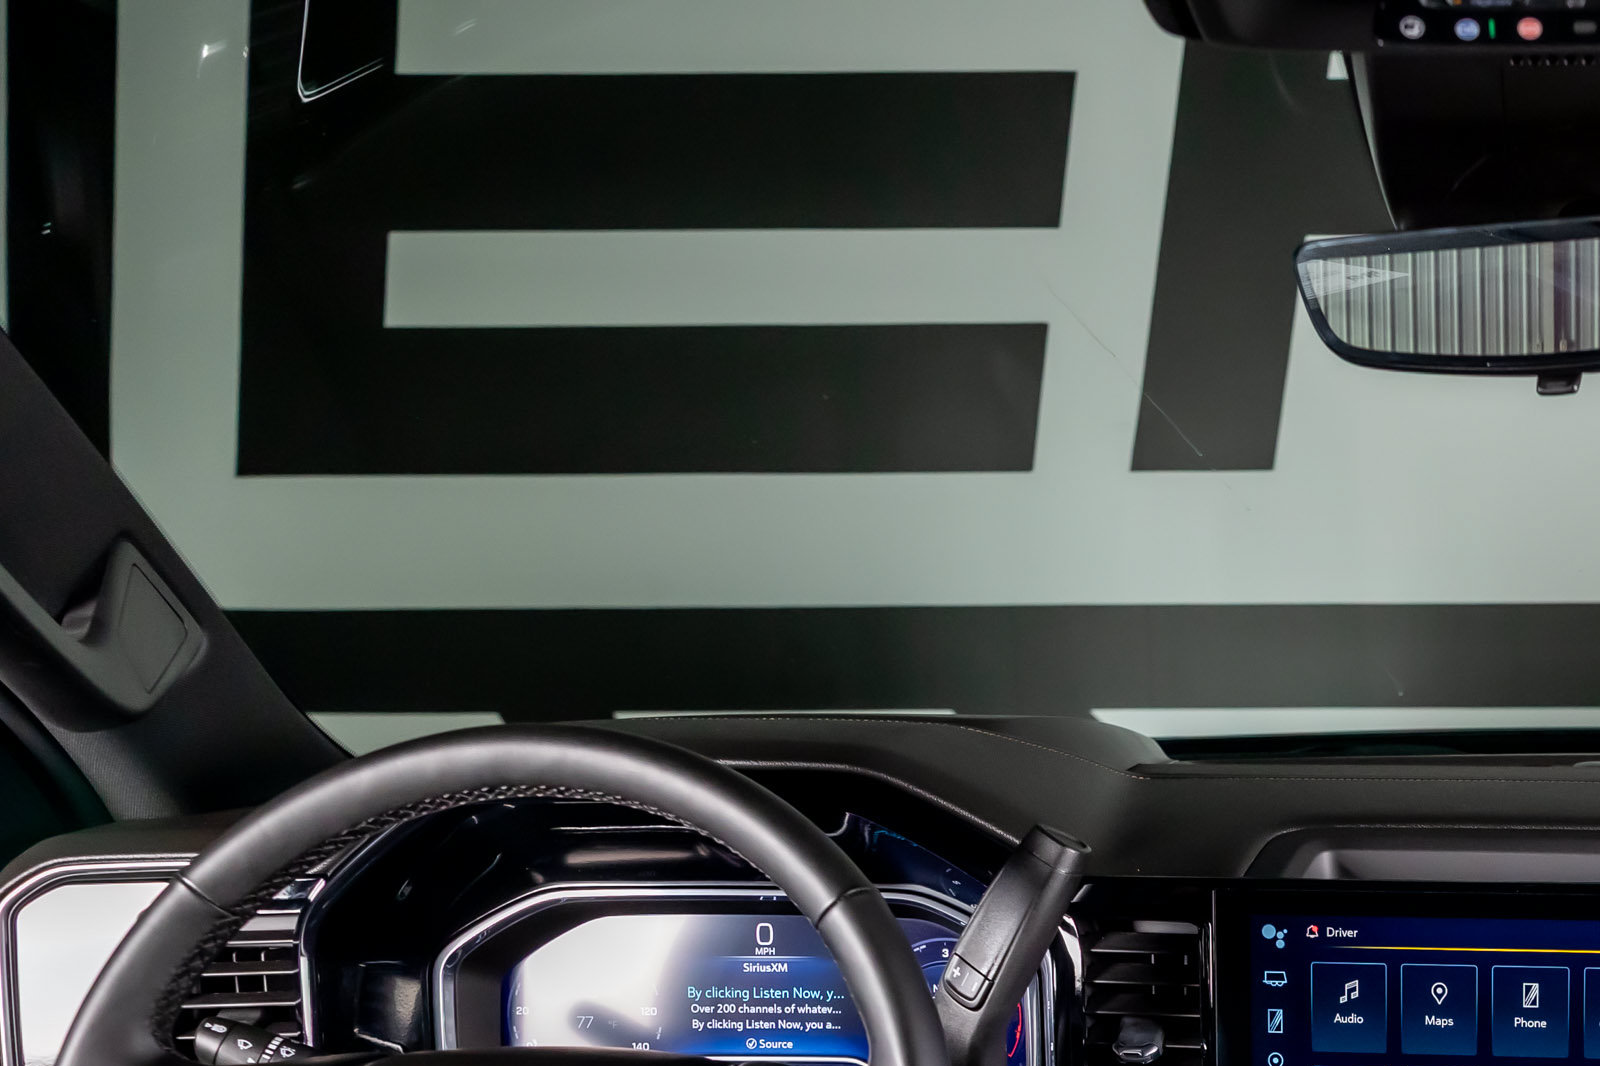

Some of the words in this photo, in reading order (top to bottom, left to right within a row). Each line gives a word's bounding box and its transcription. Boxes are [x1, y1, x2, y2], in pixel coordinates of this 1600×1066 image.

[755, 922, 775, 946] 0
[1326, 926, 1359, 938] Driver
[754, 947, 776, 956] MPH
[941, 948, 950, 958] 3
[742, 962, 789, 973] SiriusXM
[687, 985, 703, 1002] By
[705, 985, 750, 1002] clicking
[752, 986, 790, 1000] Listen
[792, 986, 824, 1002] Now,
[826, 989, 845, 1002] y...
[640, 1006, 658, 1017] 120
[690, 1003, 715, 1014] Over
[716, 1003, 737, 1014] 200
[738, 1002, 783, 1014] channels
[784, 1002, 797, 1014] of
[797, 1003, 842, 1015] whatev...
[576, 1015, 595, 1030] 77
[1333, 1012, 1365, 1025] Audio
[1424, 1015, 1455, 1029] Maps
[1513, 1016, 1548, 1029] Phone
[692, 1018, 705, 1032] By
[706, 1018, 744, 1032] clicking
[745, 1019, 776, 1031] Listen
[777, 1019, 804, 1032] Now,
[805, 1021, 824, 1033] you
[825, 1022, 842, 1030] a...
[631, 1042, 650, 1051] 140
[758, 1039, 794, 1049] Source
